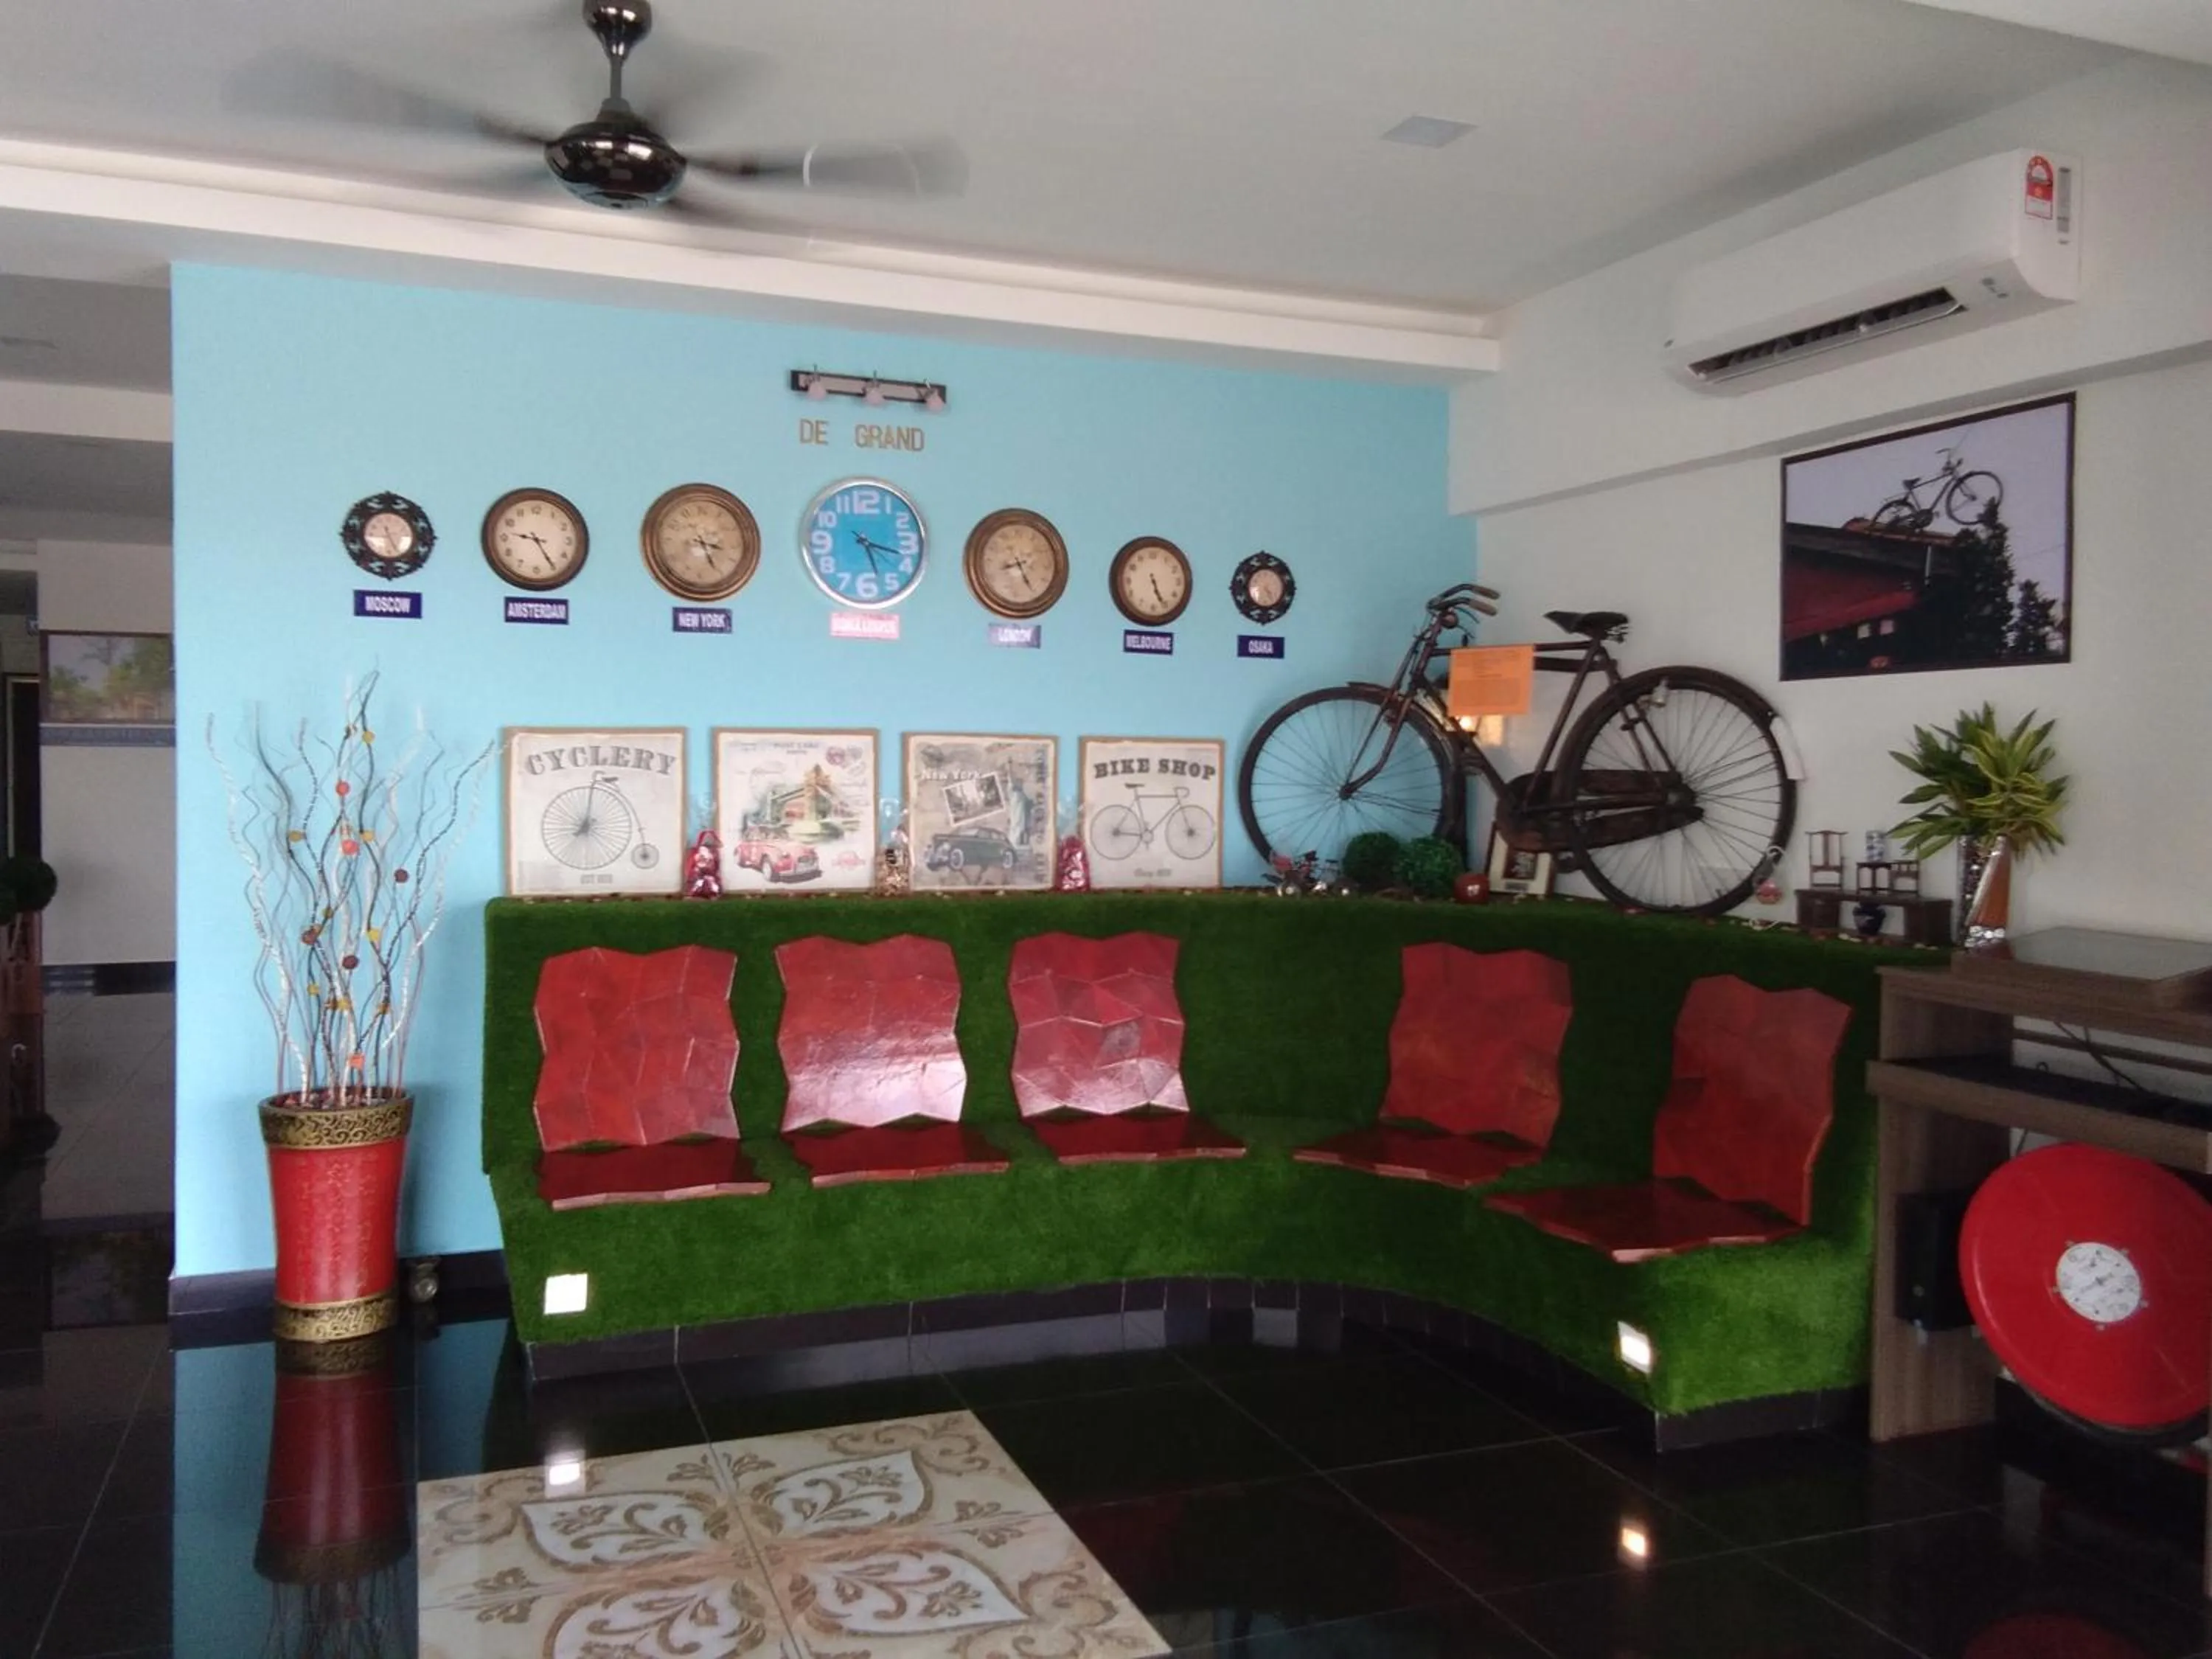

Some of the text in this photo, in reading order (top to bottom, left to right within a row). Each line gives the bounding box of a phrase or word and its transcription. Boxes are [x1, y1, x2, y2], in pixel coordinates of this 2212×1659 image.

[799, 418, 925, 452] DE GRAND
[836, 490, 891, 515] 11 12 1
[818, 511, 837, 528] 10
[897, 511, 910, 529] 2
[812, 530, 833, 554] 9
[897, 531, 919, 554] 3
[819, 556, 835, 574] 8
[898, 557, 913, 575] 4
[835, 572, 900, 598] 7 6 5
[365, 596, 411, 613] MOSCOW
[507, 602, 566, 619] AMSTERDAM
[678, 613, 726, 628] NEW YORK
[1126, 634, 1172, 651] MELBOURNE
[1248, 640, 1274, 654] OSAKA
[524, 745, 677, 775] CYCLERY
[1093, 758, 1216, 780] BIKE SHOP
